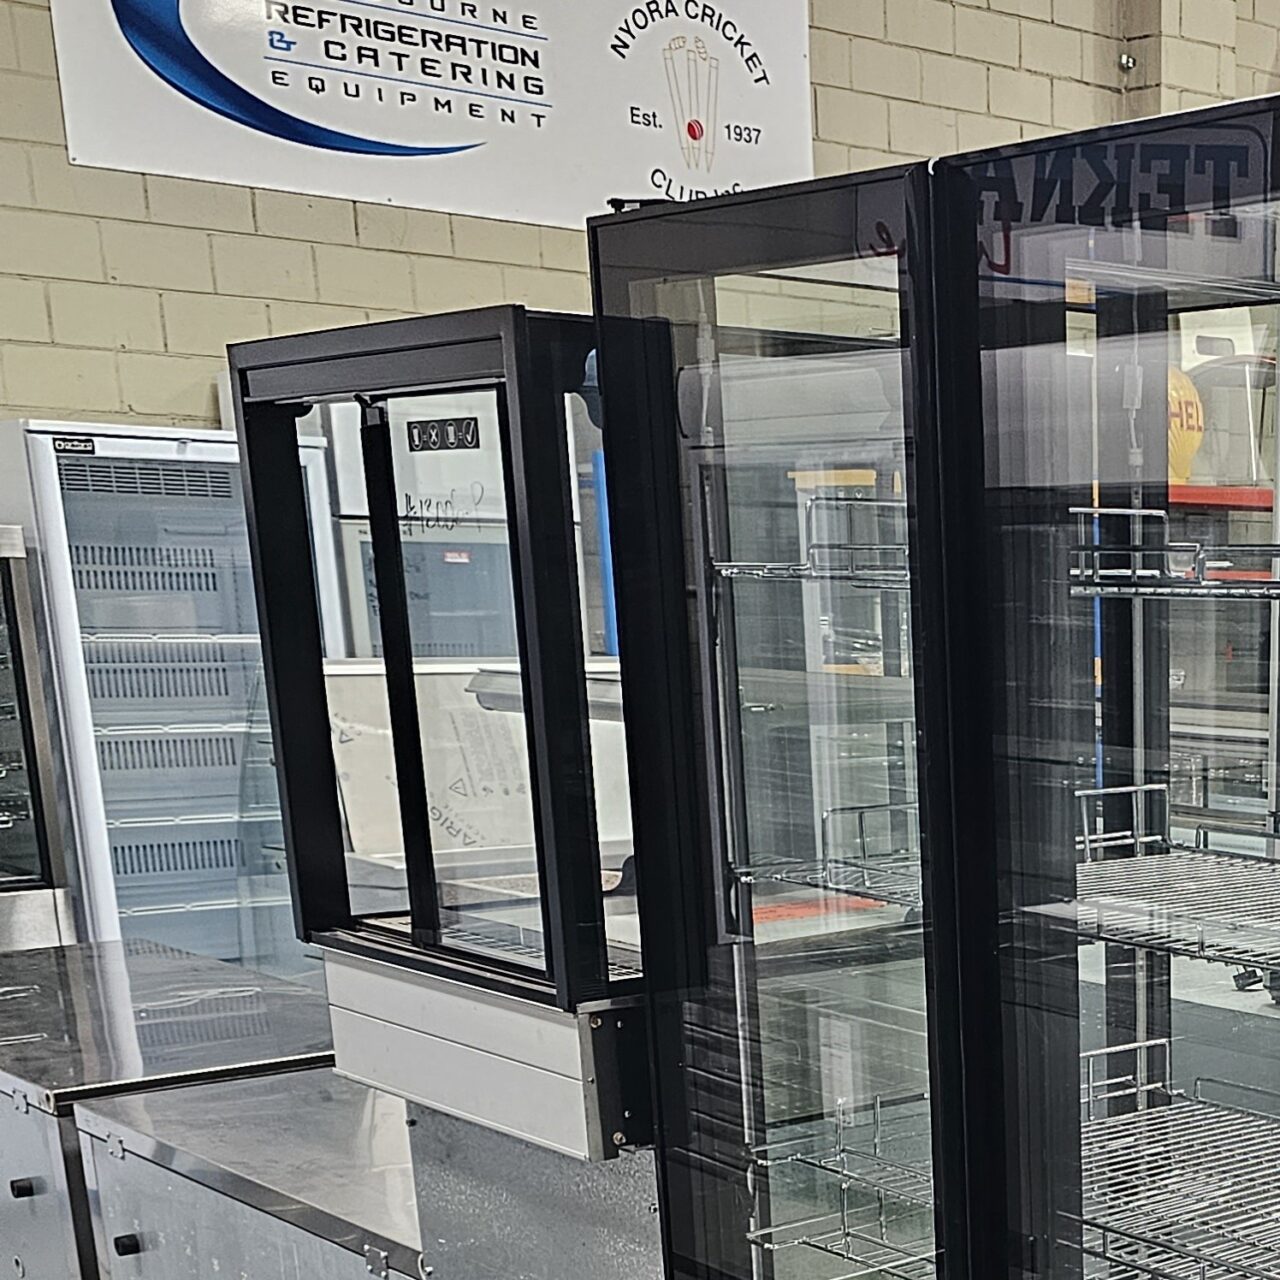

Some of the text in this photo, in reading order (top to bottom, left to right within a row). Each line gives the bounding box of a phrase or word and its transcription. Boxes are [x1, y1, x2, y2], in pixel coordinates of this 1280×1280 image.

[266, 0, 540, 68] REFRIGERATION
[268, 31, 544, 95] & CATERING
[610, 0, 770, 86] NYORA CRICKET
[271, 70, 546, 128] EQUIPMENT
[630, 106, 663, 128] Est.
[724, 123, 762, 145] 1937
